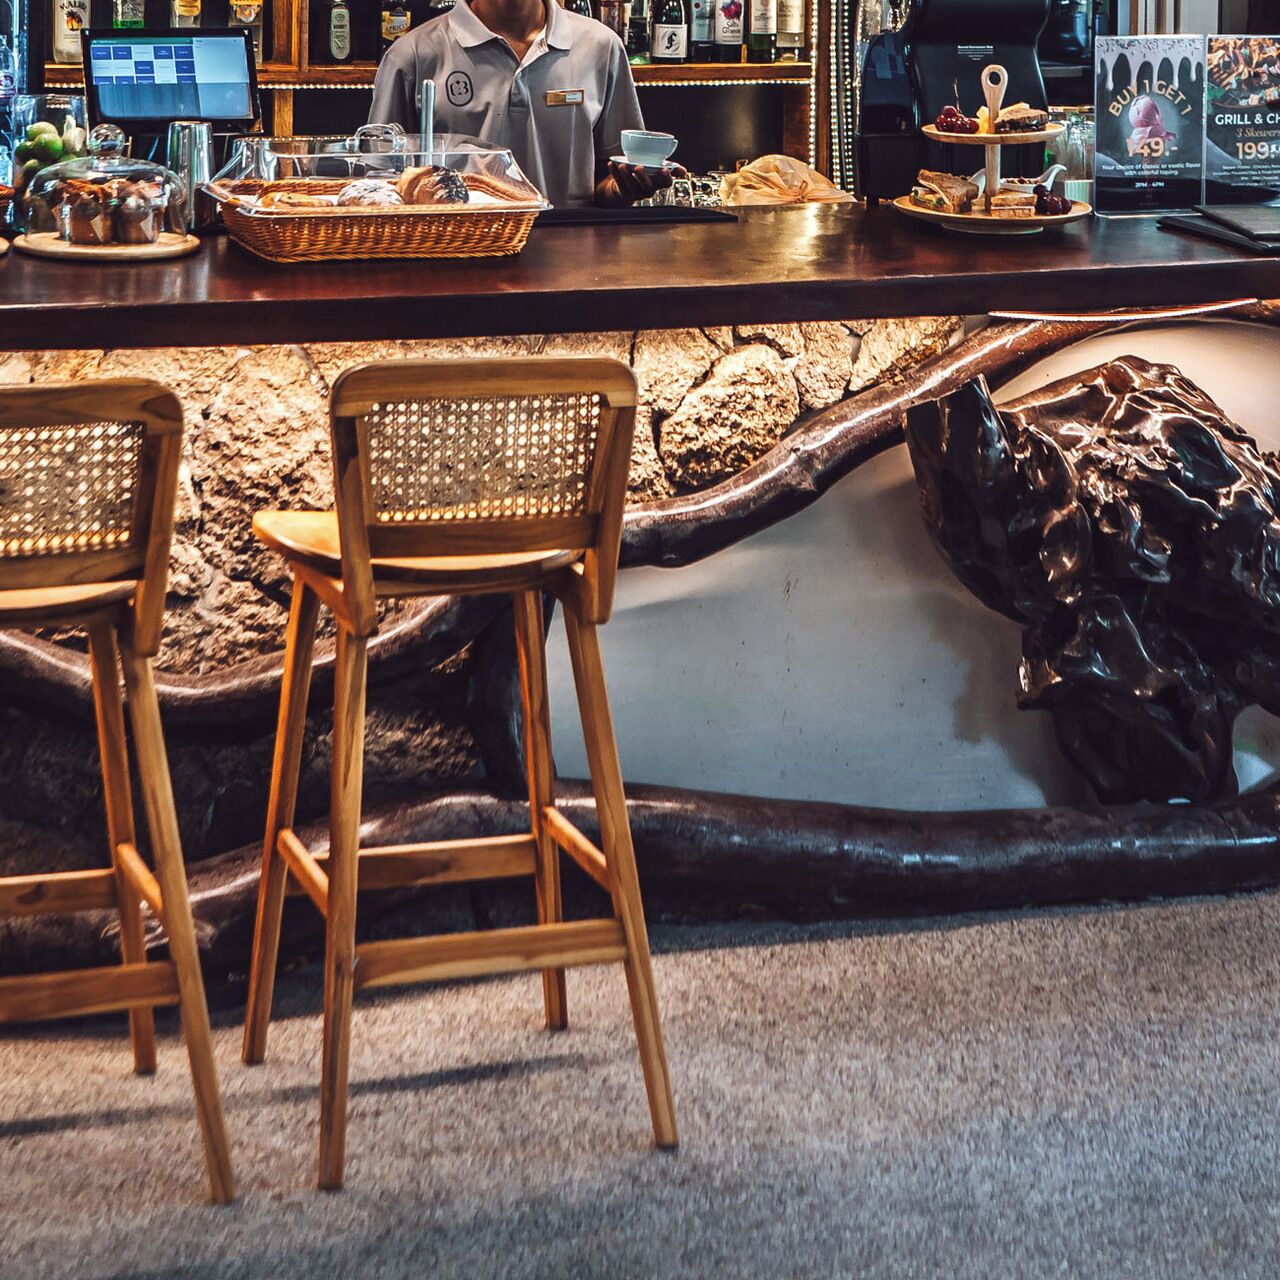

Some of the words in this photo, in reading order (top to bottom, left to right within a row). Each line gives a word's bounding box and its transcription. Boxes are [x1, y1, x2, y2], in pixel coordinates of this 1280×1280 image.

[1108, 84, 1138, 117] BUY
[1143, 79, 1150, 94] 1
[1154, 80, 1187, 105] GET
[1181, 103, 1193, 116] 1
[1215, 113, 1251, 125] GRILL
[1254, 113, 1263, 124] &
